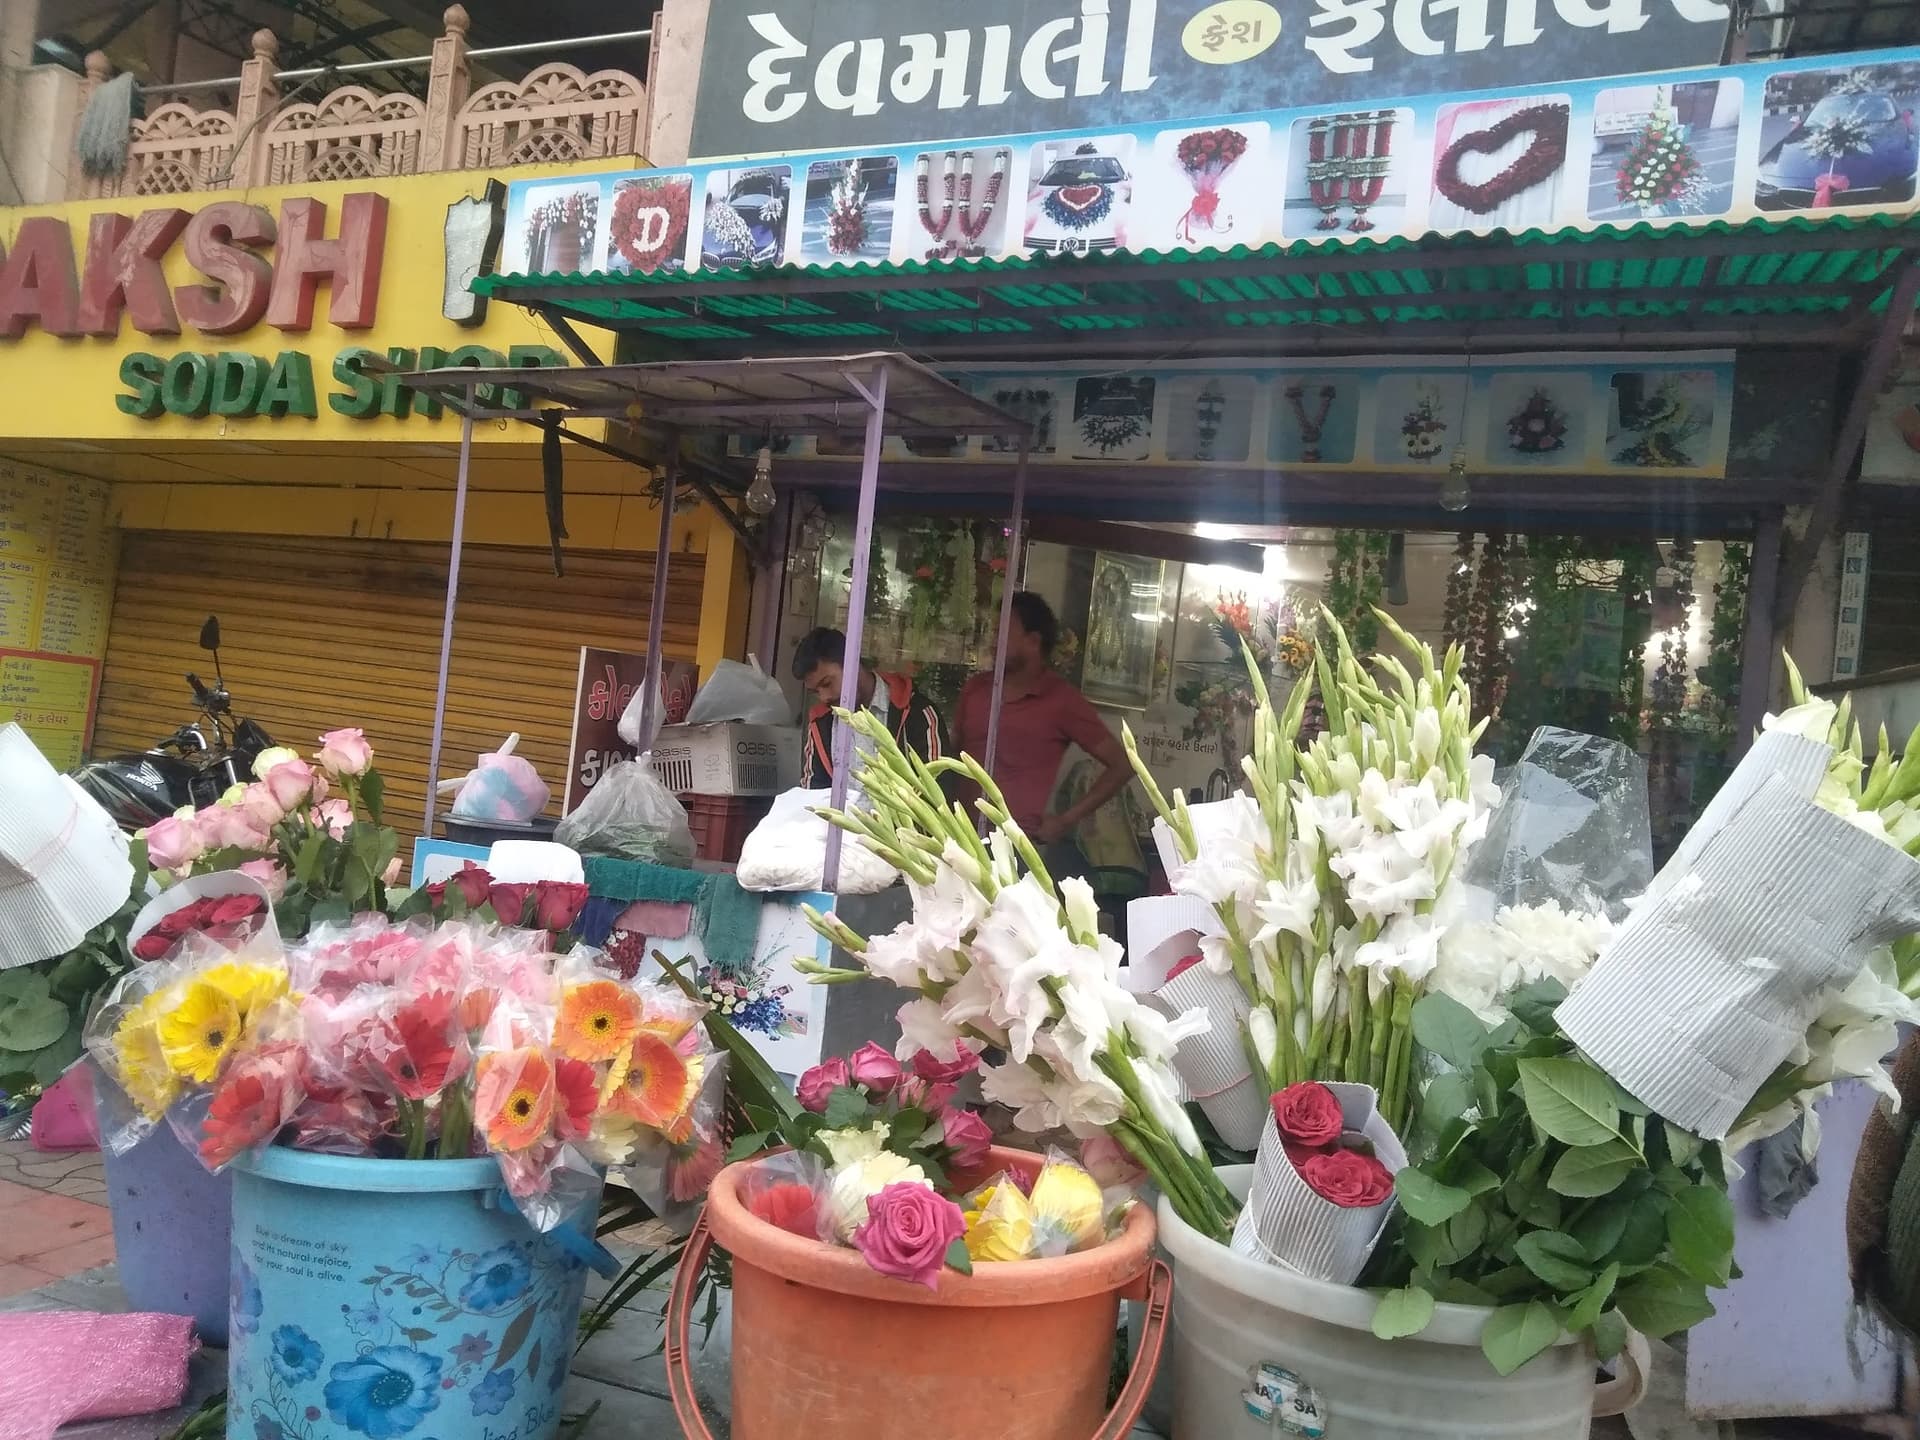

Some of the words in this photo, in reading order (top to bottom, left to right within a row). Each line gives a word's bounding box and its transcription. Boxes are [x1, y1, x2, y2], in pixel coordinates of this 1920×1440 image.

[0, 192, 389, 341] AKSH
[114, 351, 318, 419] SODA
[125, 772, 158, 791] HONDA
[280, 1234, 311, 1248] dream
[314, 1240, 325, 1250] of
[330, 1242, 347, 1254] sky
[276, 1248, 310, 1263] natural
[313, 1255, 352, 1270] rejoice,
[286, 1265, 303, 1276] soul
[306, 1268, 314, 1278] is
